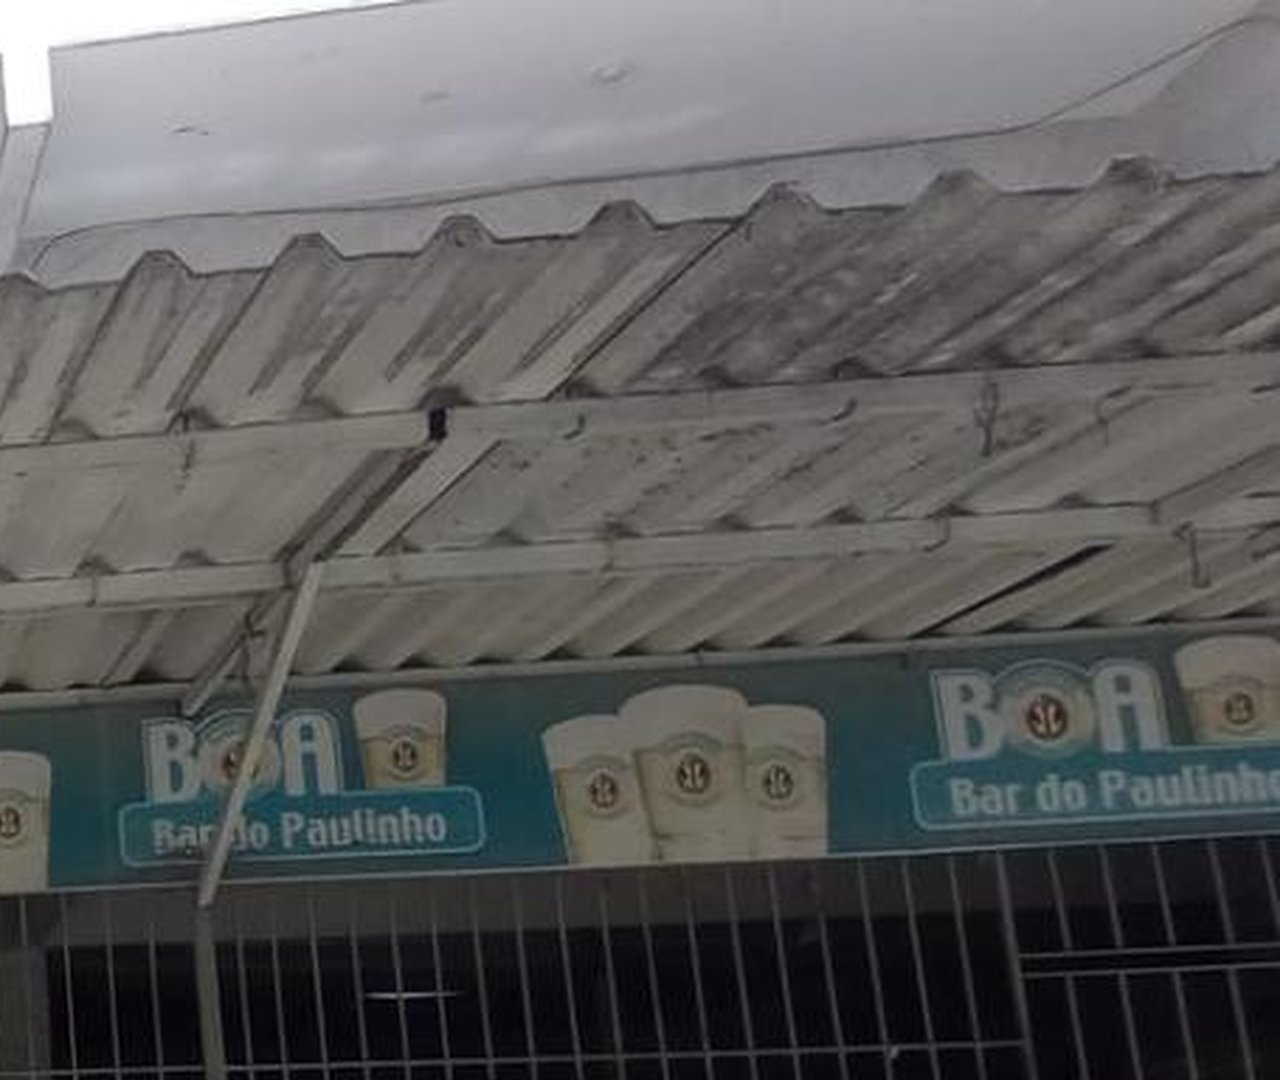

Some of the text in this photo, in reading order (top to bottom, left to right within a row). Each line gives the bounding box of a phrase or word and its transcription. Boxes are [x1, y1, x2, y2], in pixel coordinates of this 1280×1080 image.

[933, 659, 1167, 762] BOA
[145, 709, 341, 803] BOA
[152, 817, 214, 854] Bar
[280, 807, 448, 849] Paulinho
[948, 778, 1023, 818] Bar
[1036, 774, 1088, 812] do
